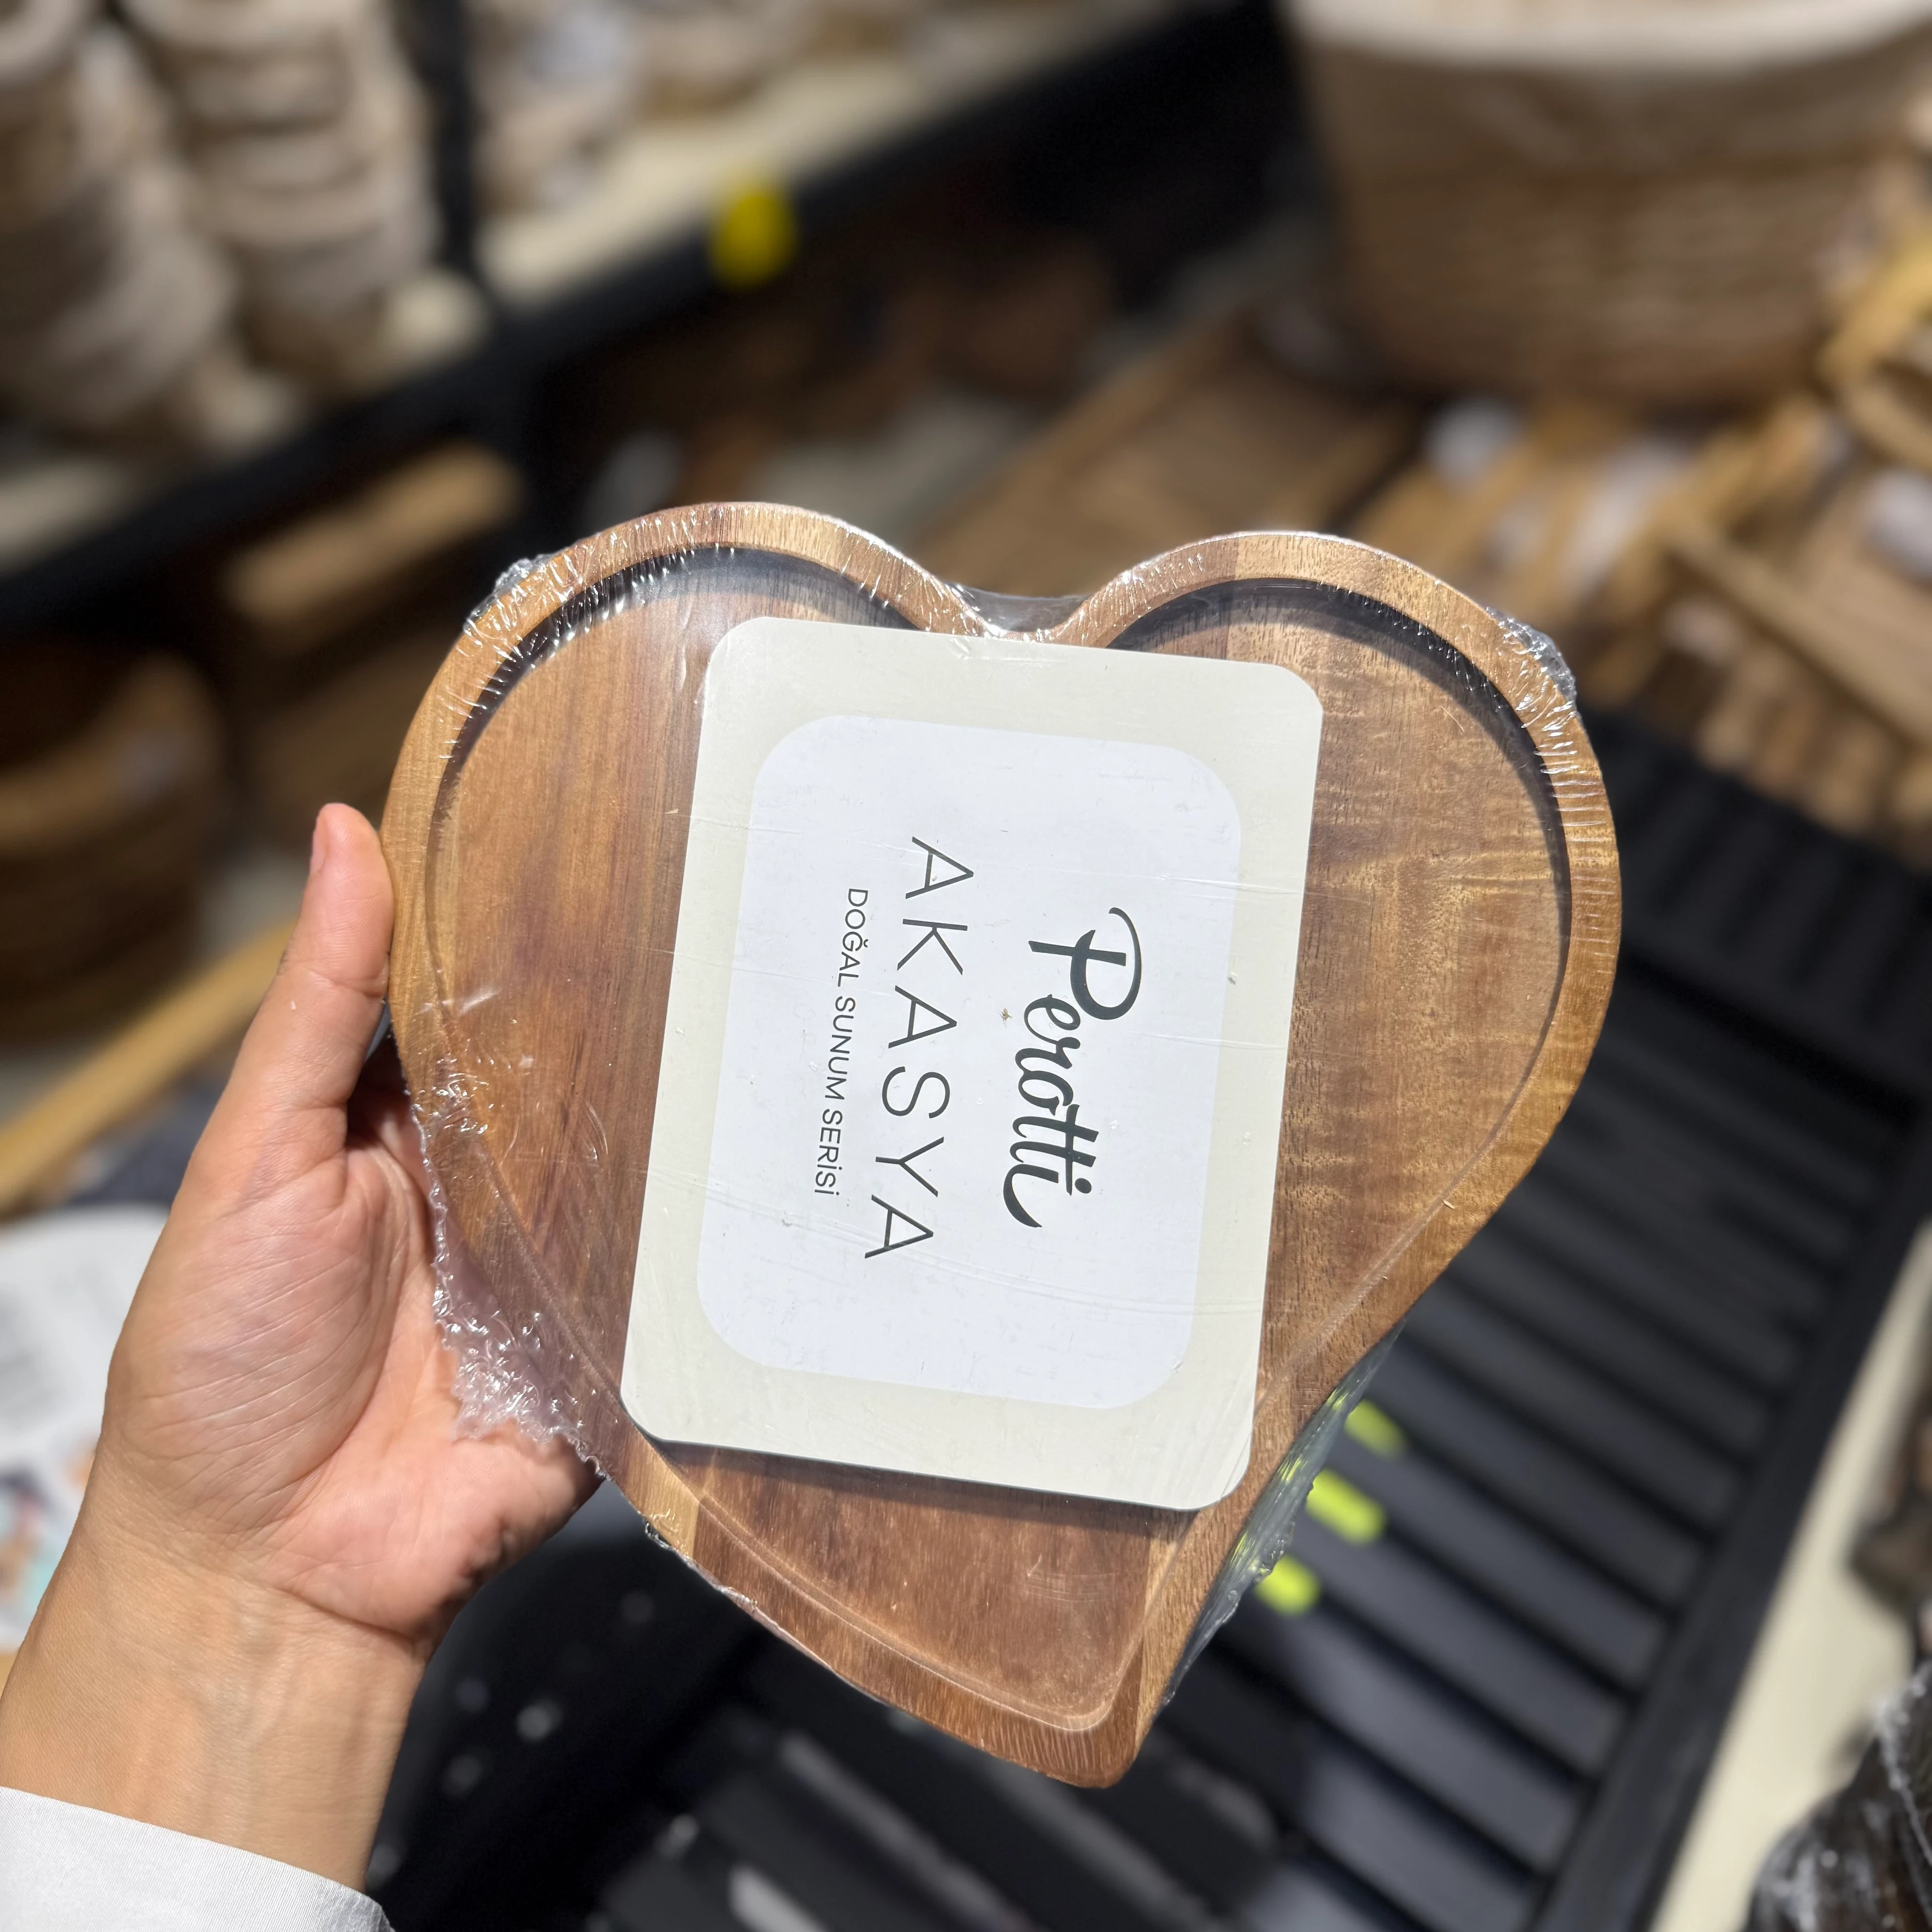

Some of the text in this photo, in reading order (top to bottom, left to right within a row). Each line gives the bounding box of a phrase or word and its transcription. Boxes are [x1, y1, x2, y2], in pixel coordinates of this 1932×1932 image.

[814, 888, 869, 1196] DOĞAL SUNUM SERİSİ
[864, 836, 975, 1259] AKASYA
[1002, 907, 1143, 1228] Perotti
